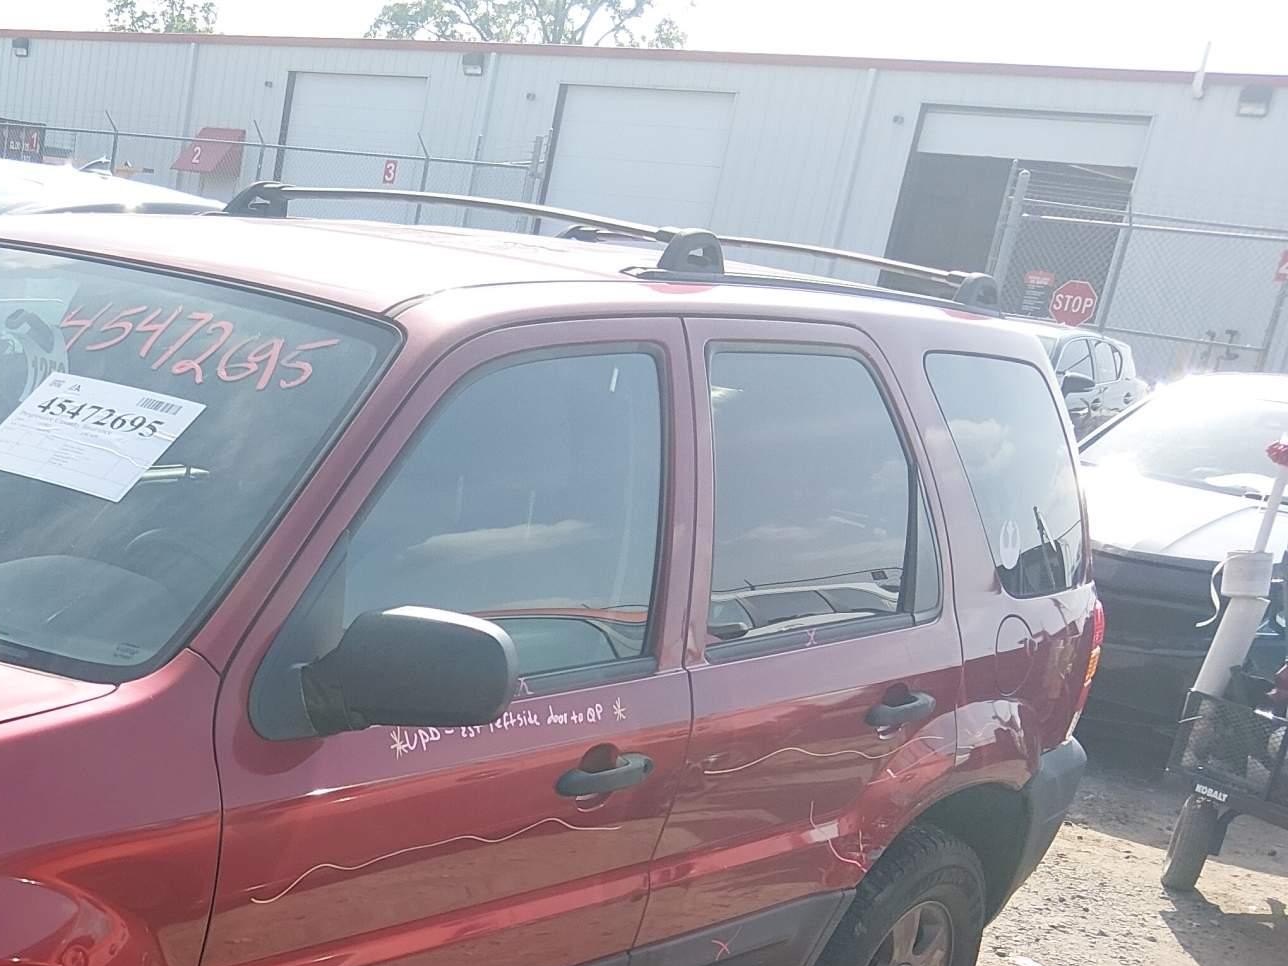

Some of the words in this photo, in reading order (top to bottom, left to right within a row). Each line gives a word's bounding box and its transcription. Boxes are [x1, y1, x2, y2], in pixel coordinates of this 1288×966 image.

[191, 147, 202, 164] 2
[384, 162, 396, 182] 3
[1053, 293, 1094, 314] STOP
[60, 303, 340, 391] 45472695
[37, 396, 166, 438] 45472695
